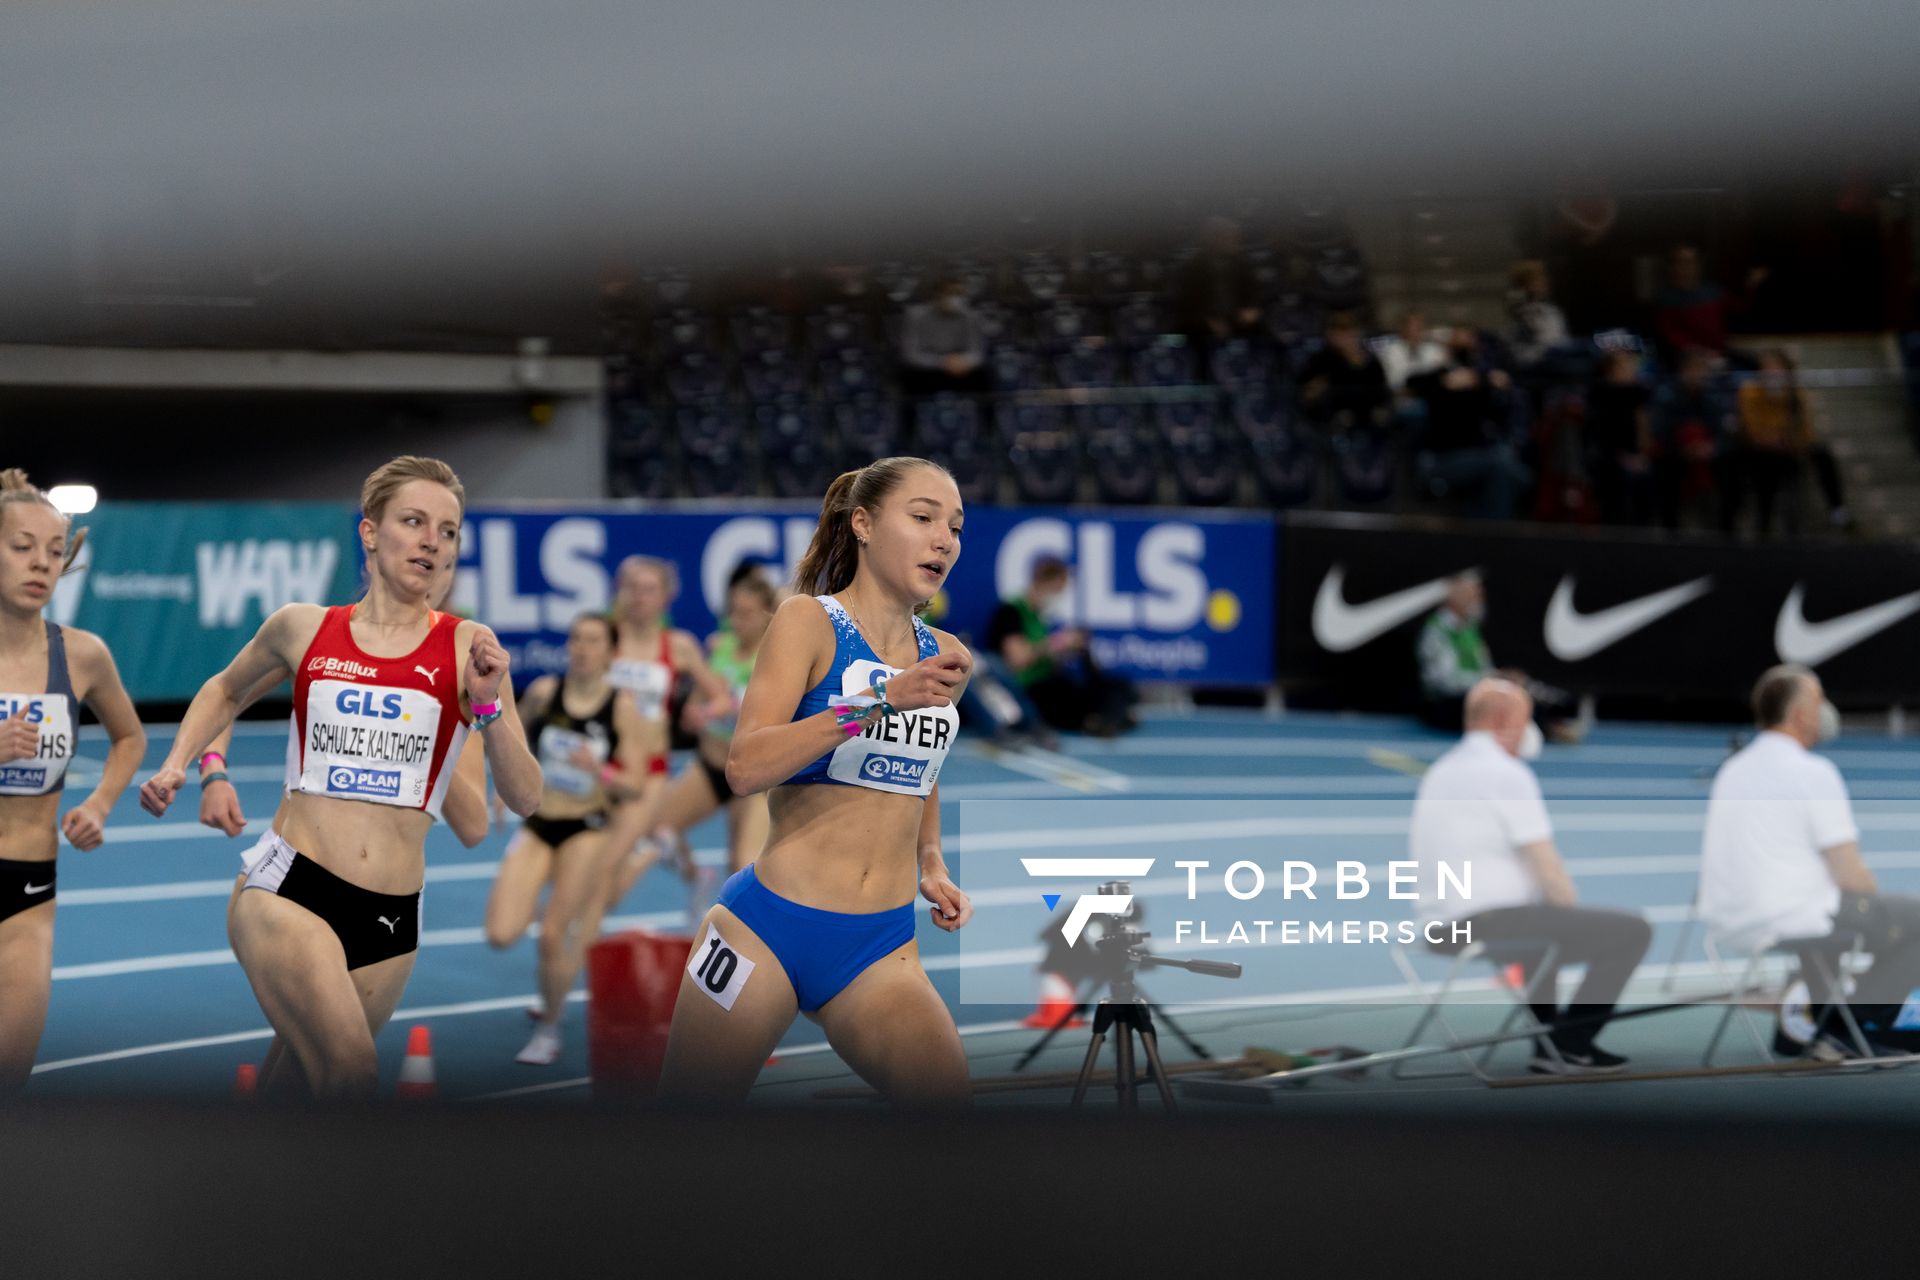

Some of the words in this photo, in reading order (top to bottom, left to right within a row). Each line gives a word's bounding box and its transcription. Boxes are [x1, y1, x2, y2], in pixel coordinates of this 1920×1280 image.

[325, 657, 378, 678] Brillux
[311, 722, 366, 758] SCHULZE
[366, 729, 430, 764] KALTHOFF
[7, 770, 45, 783] PLAN
[891, 761, 925, 777] PLAN
[357, 773, 399, 788] PLAN
[696, 937, 738, 994] 10
